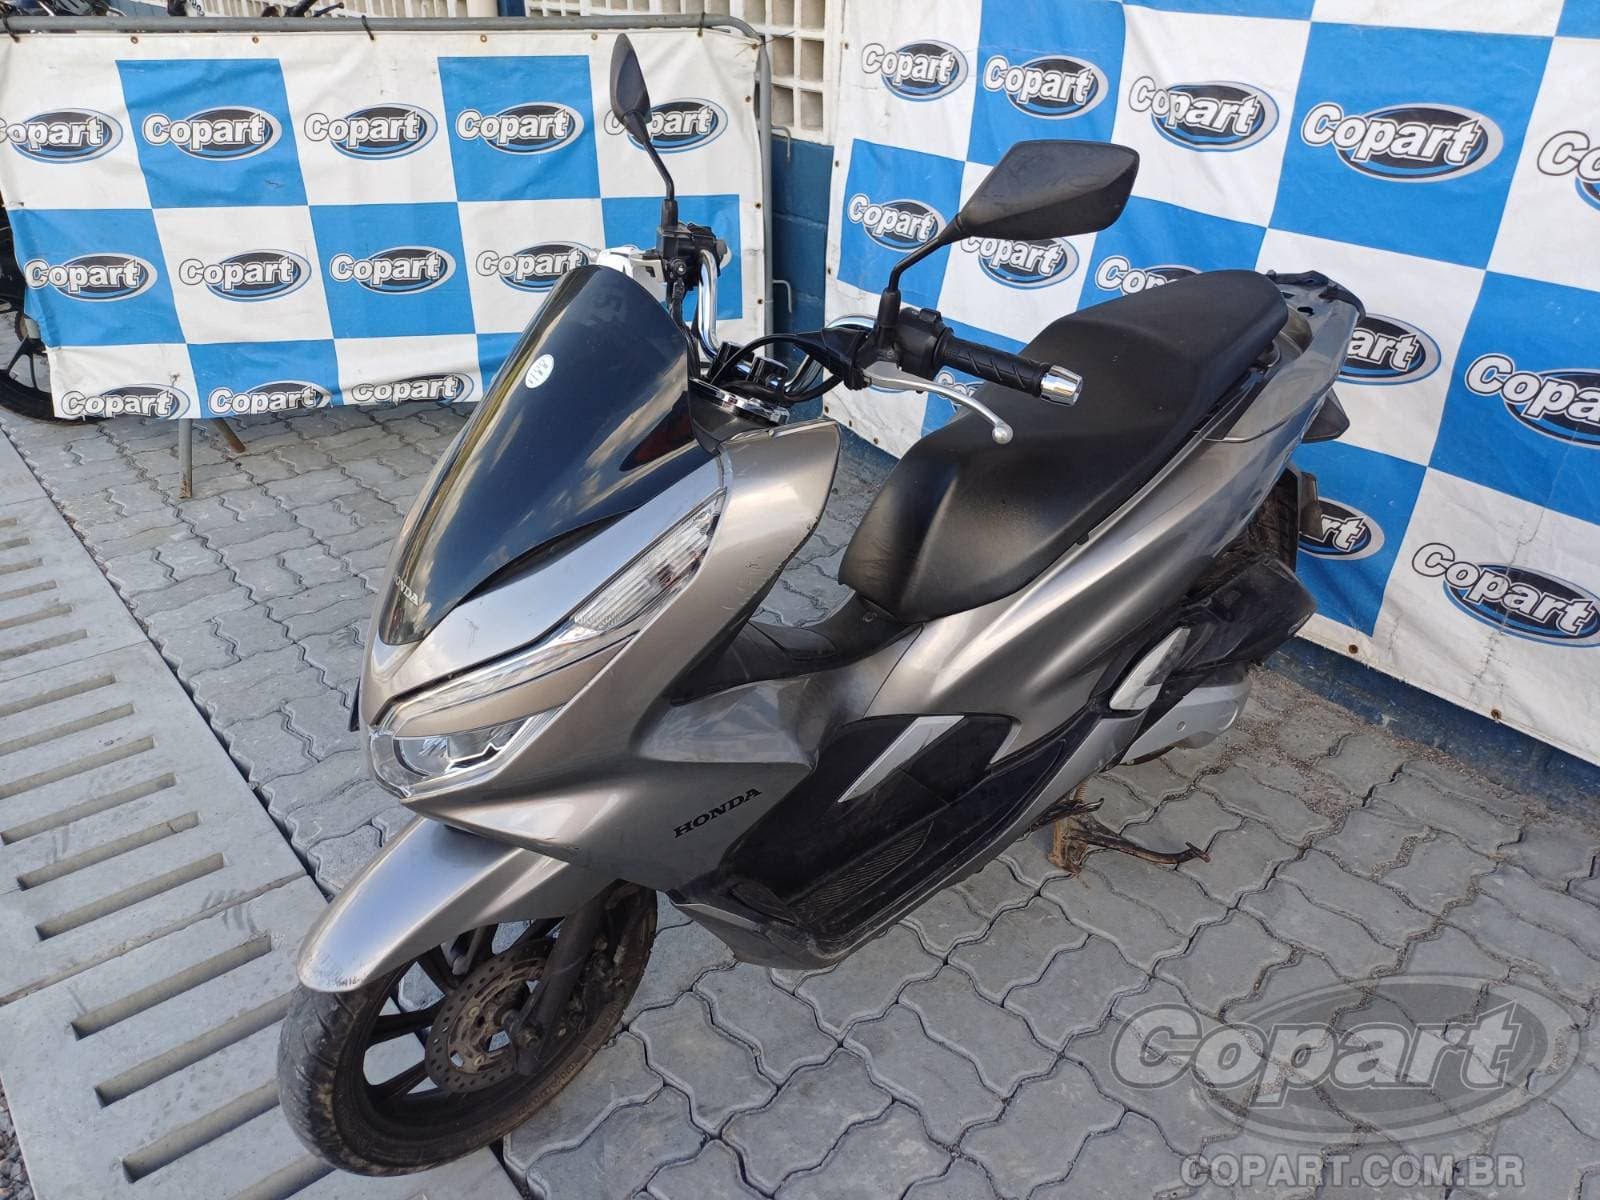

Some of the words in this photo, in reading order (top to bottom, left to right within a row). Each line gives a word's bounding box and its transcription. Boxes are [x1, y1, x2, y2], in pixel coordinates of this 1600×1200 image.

[861, 43, 955, 86] Copart
[983, 55, 1095, 105] Copart
[456, 106, 571, 145] Copart
[1129, 76, 1263, 136] Copart
[144, 113, 266, 150] Copart
[304, 110, 421, 149] Copart
[1300, 102, 1482, 165] Copart
[848, 193, 937, 242] Copart
[24, 258, 141, 293] Copart
[179, 255, 295, 292] Copart
[330, 251, 443, 286] Copart
[476, 248, 583, 282] Copart
[960, 236, 1064, 276] Copart
[61, 389, 173, 419] Copart
[209, 384, 318, 416] Copart
[352, 374, 458, 405] Copart
[1465, 353, 1600, 425] Copa
[1412, 542, 1595, 637] Copart
[673, 788, 762, 838] HONDA
